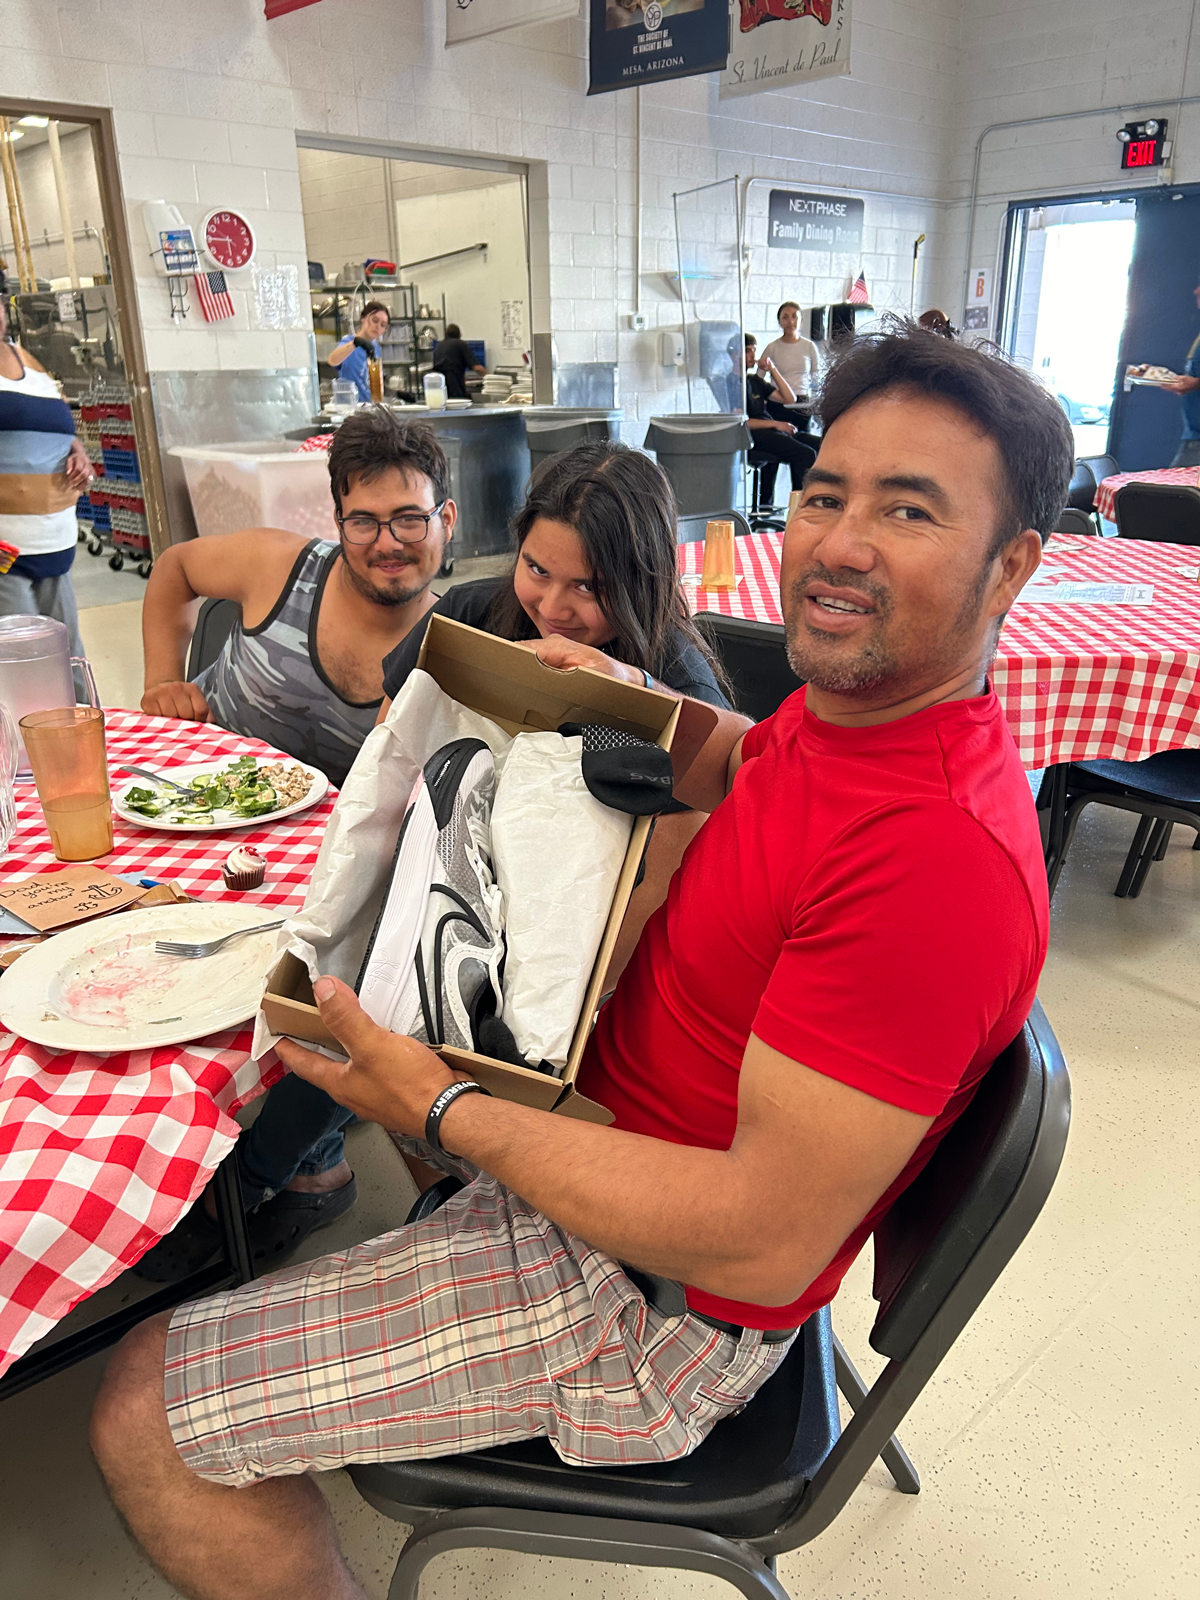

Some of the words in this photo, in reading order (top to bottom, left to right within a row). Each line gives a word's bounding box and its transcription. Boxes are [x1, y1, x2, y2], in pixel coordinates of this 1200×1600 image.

[637, 33, 646, 43] THE
[646, 30, 663, 41] SOCIETY
[663, 29, 669, 38] OF
[639, 41, 656, 53] VINCENT
[656, 40, 662, 50] DE
[662, 38, 673, 48] PAUL
[646, 56, 685, 71] ARIZONA
[728, 60, 746, 85] St.
[753, 55, 790, 80] Vincent
[793, 49, 805, 72] de
[809, 37, 842, 70] Paul
[1126, 140, 1157, 167] EXIT
[788, 198, 848, 217] NEXTPHASE
[221, 213, 230, 222] 12
[207, 224, 217, 233] 10
[240, 226, 247, 236] 2
[772, 220, 804, 242] Family
[806, 223, 833, 244] Dining
[243, 237, 250, 246] 3
[217, 255, 224, 263] 7
[241, 248, 248, 256] 4
[975, 277, 985, 298] B
[630, 773, 674, 785] BAS
[22, 881, 70, 899] you're
[47, 886, 76, 896] my
[27, 892, 74, 909] anchor
